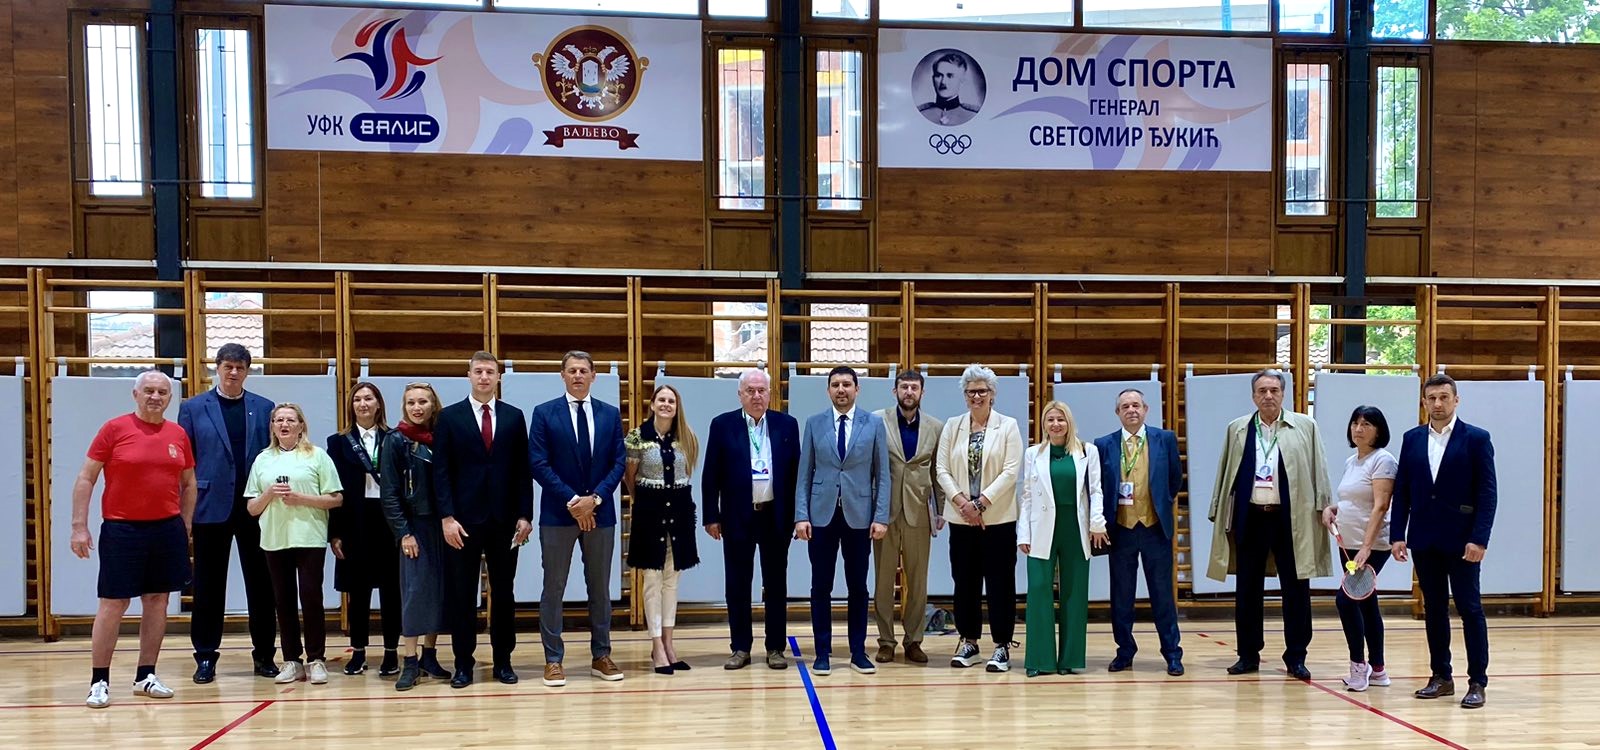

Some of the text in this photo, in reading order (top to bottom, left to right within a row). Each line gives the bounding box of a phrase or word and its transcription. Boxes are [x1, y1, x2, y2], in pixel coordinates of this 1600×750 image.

[1012, 57, 1236, 92] ДОМ СПОРТА
[1089, 99, 1160, 116] ГЕНЕРАЛ
[307, 114, 344, 136] УФК
[563, 127, 620, 138] ВАЉЕВО
[1029, 125, 1219, 148] СВЕТОМИР ЂУКИЋ
